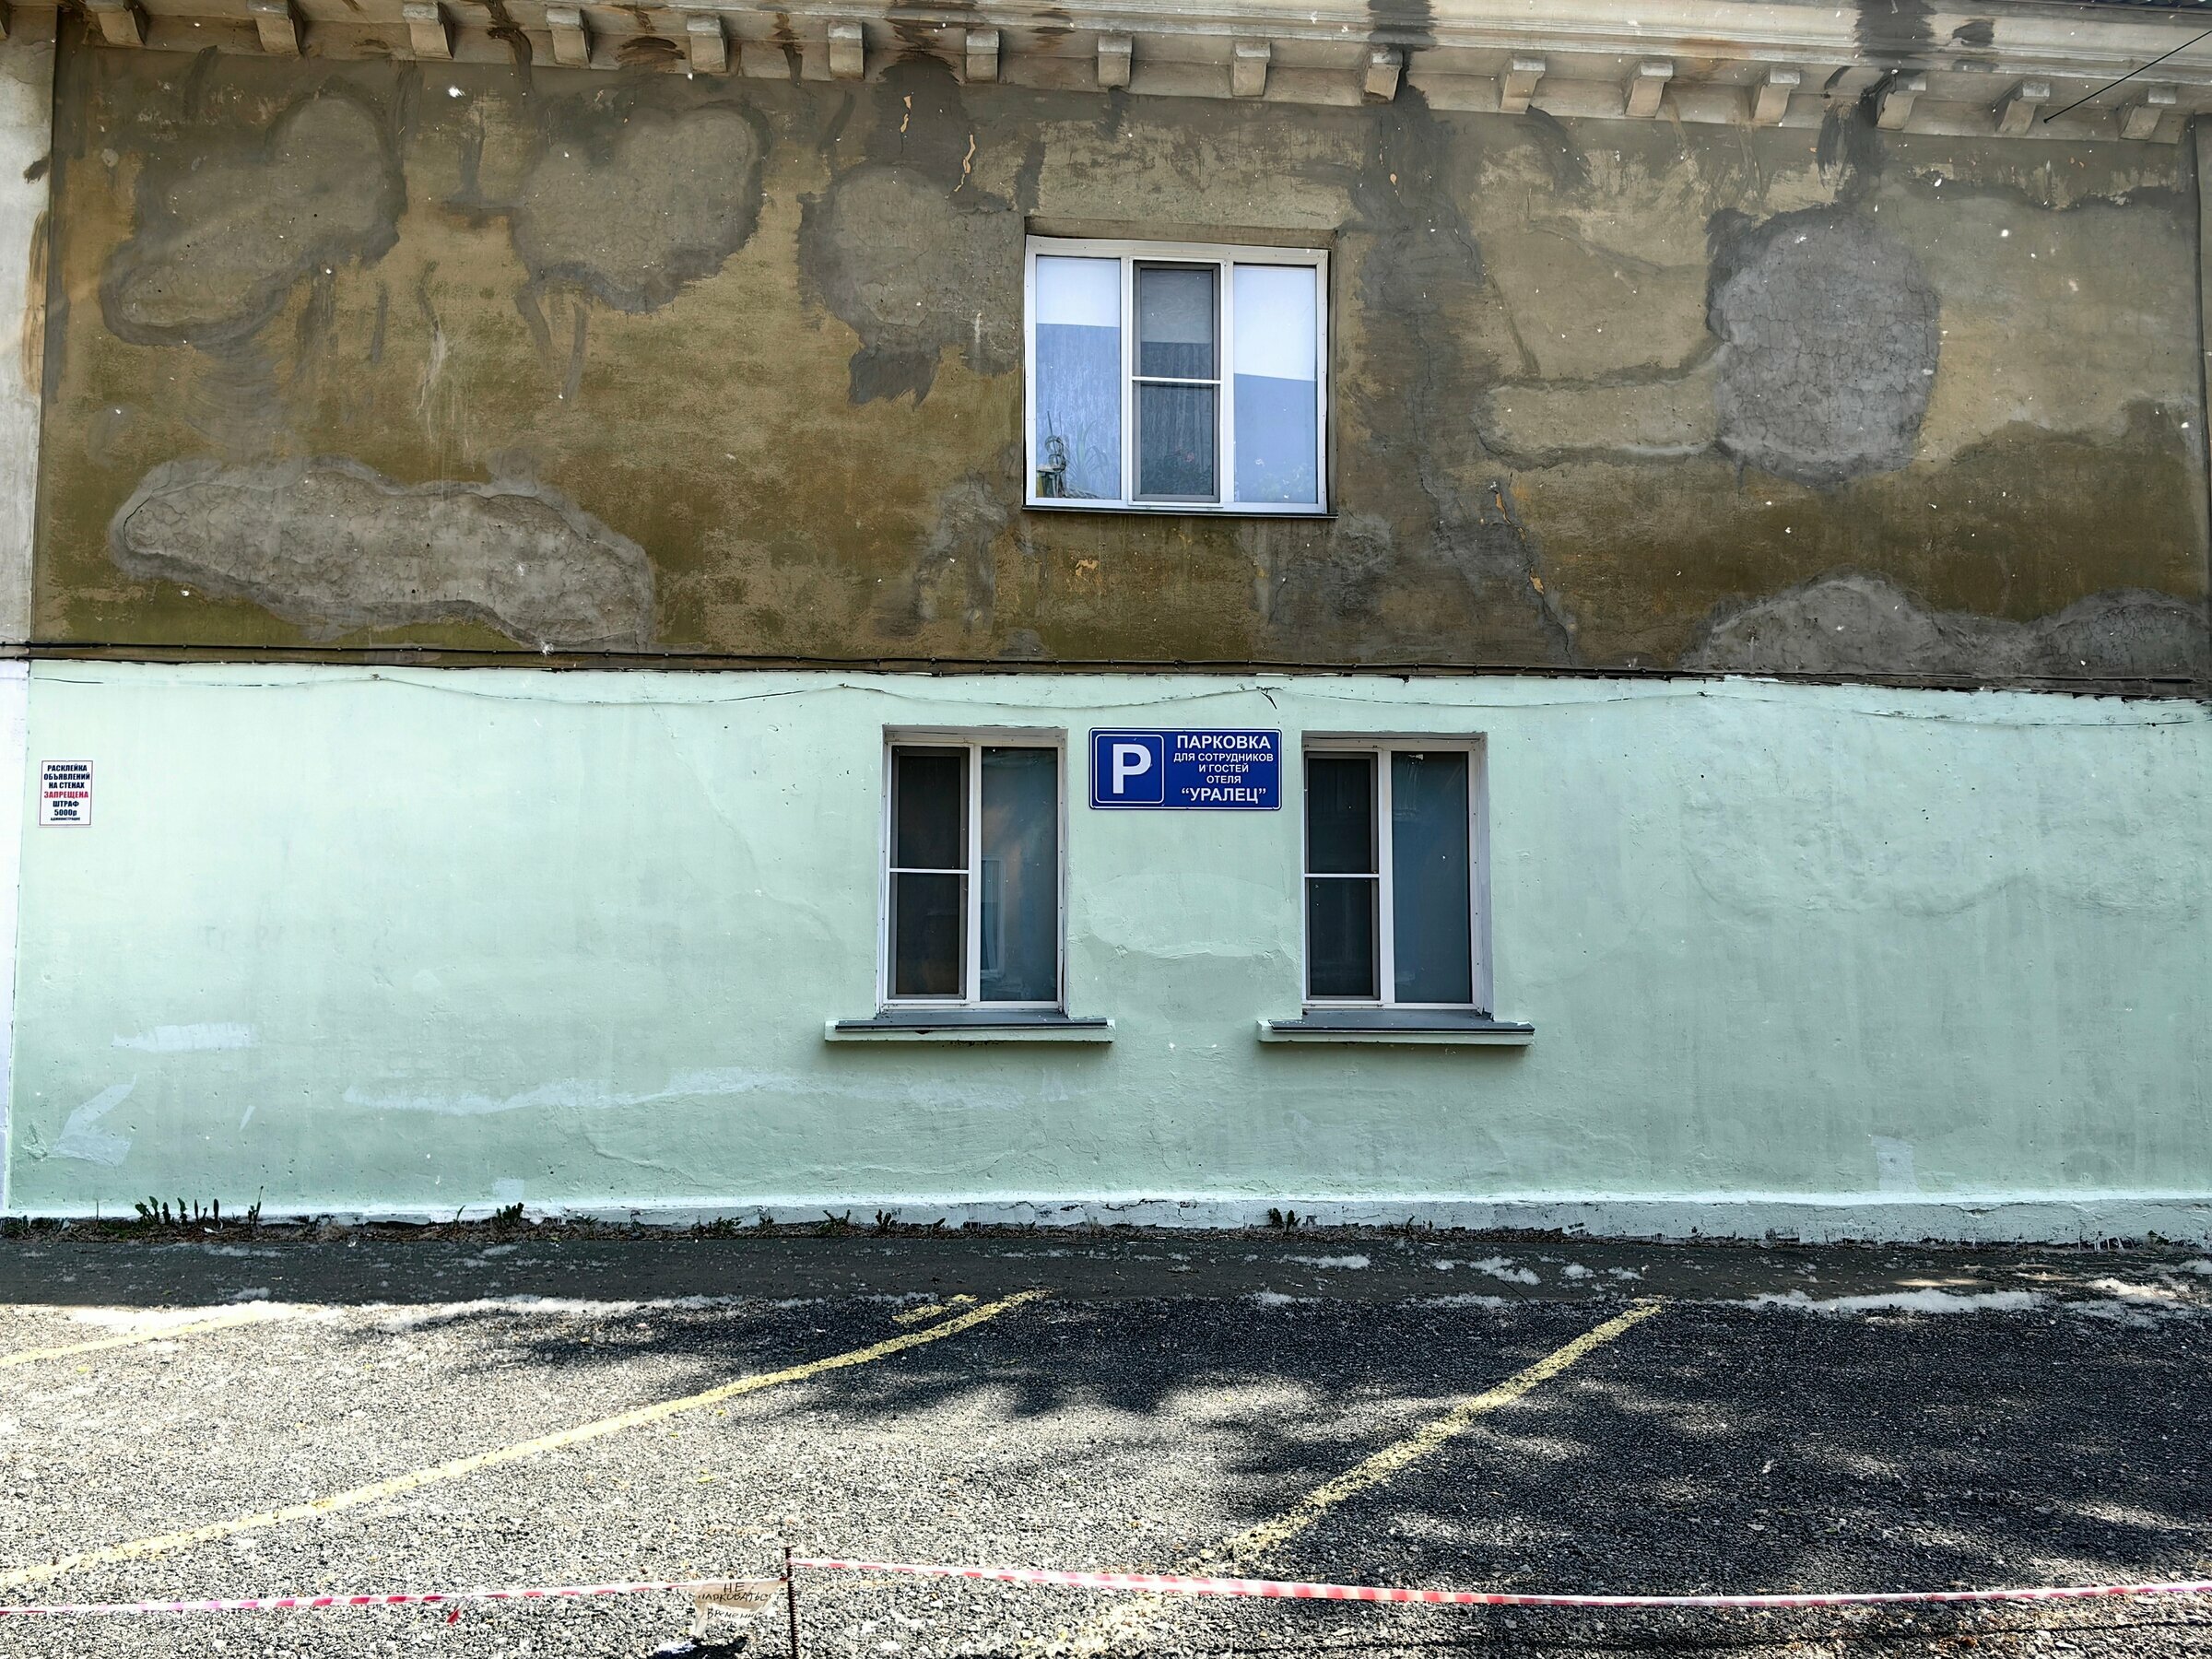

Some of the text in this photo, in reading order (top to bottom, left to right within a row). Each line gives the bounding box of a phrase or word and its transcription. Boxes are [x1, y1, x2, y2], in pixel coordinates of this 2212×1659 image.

[1177, 735, 1271, 749] ПАРКОВКА
[1173, 753, 1274, 763] ДЛЯ СОТРУДНИКОВ
[47, 763, 88, 771] РАСКЛЕЙКА
[1112, 743, 1151, 794] P
[1199, 762, 1249, 772] И ГОСТЕЙ
[43, 772, 90, 781] ОБЪЯВЛЕНИЙ
[1206, 775, 1241, 783] ОТЕЛЯ
[43, 791, 89, 799] ЗАПРЕЩЕНА
[724, 1582, 745, 1594] НЕ
